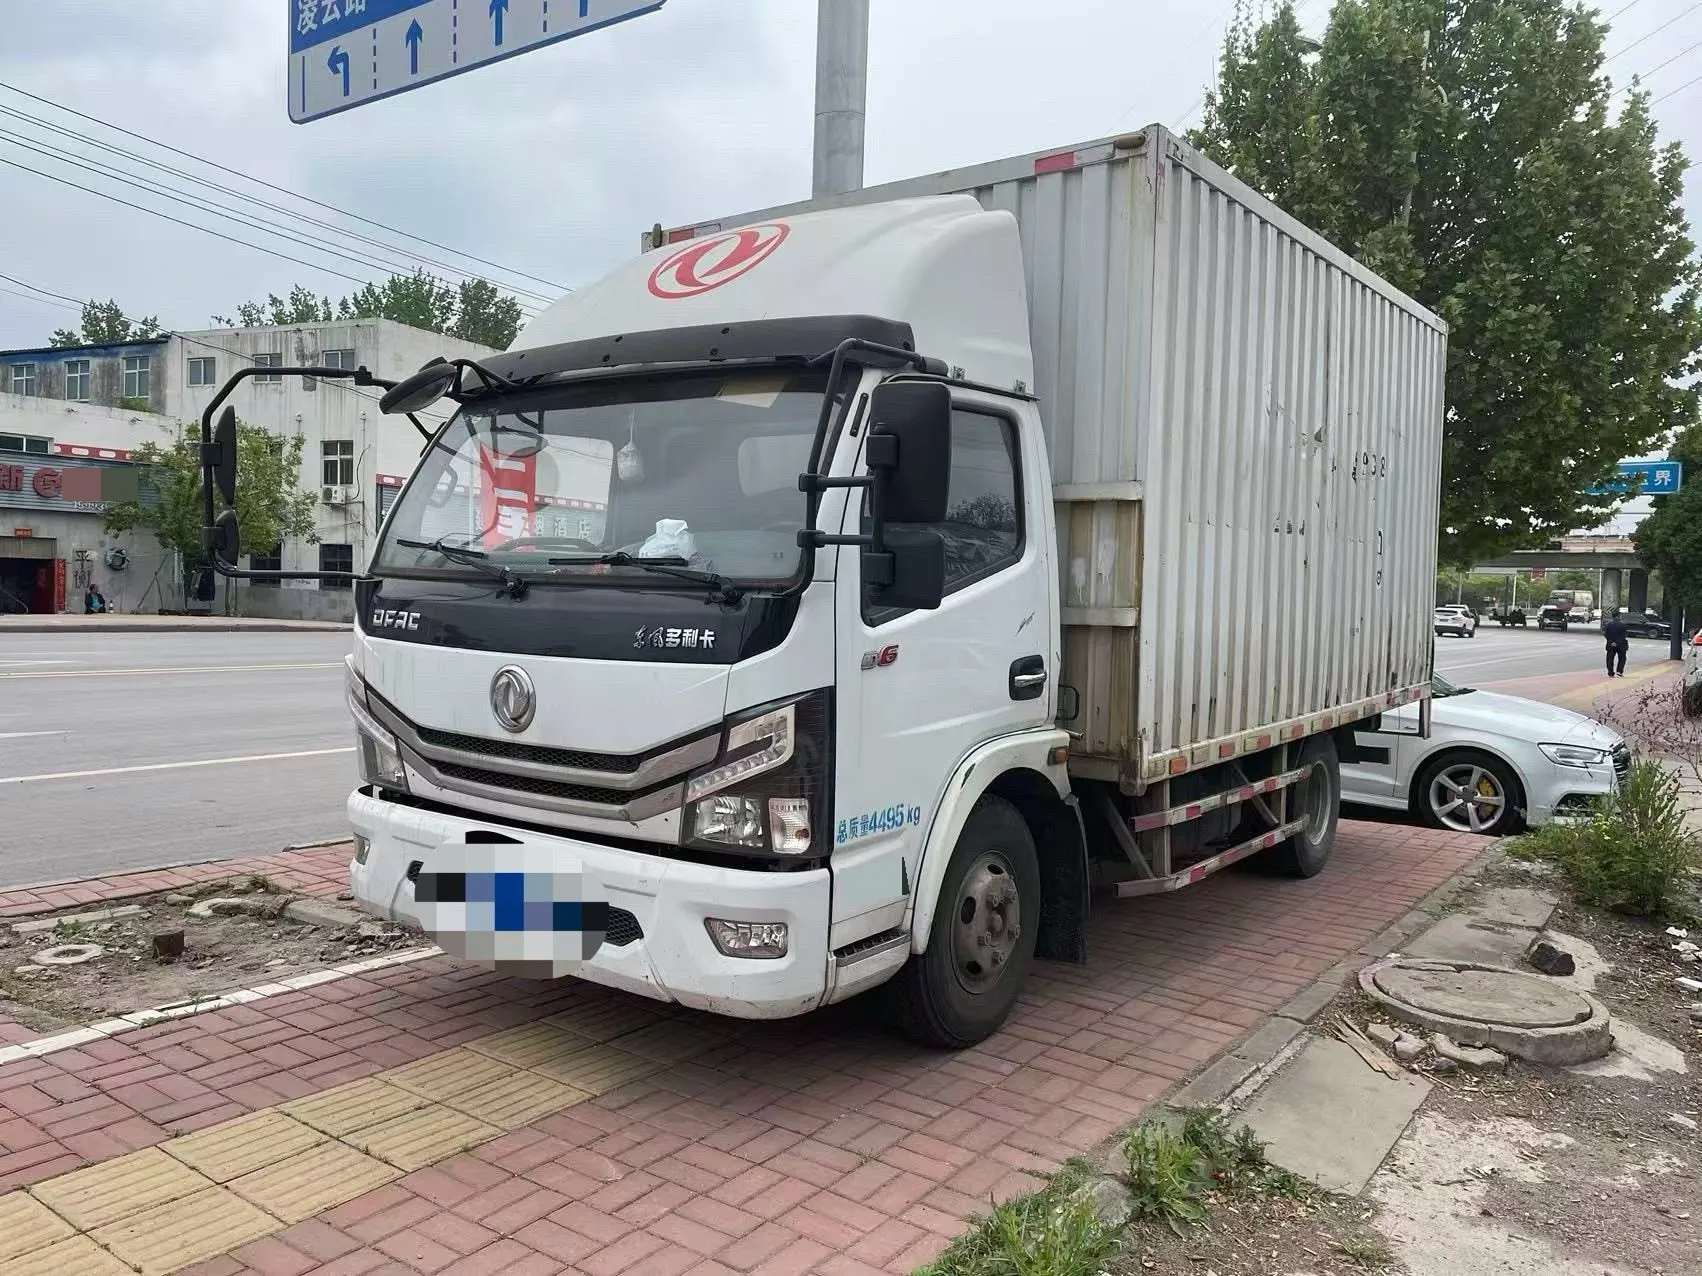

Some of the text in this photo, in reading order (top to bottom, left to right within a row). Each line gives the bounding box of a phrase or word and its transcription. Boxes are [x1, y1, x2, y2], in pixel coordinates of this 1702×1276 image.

[373, 609, 421, 630] DFAC
[633, 624, 715, 648] 东风多利卡
